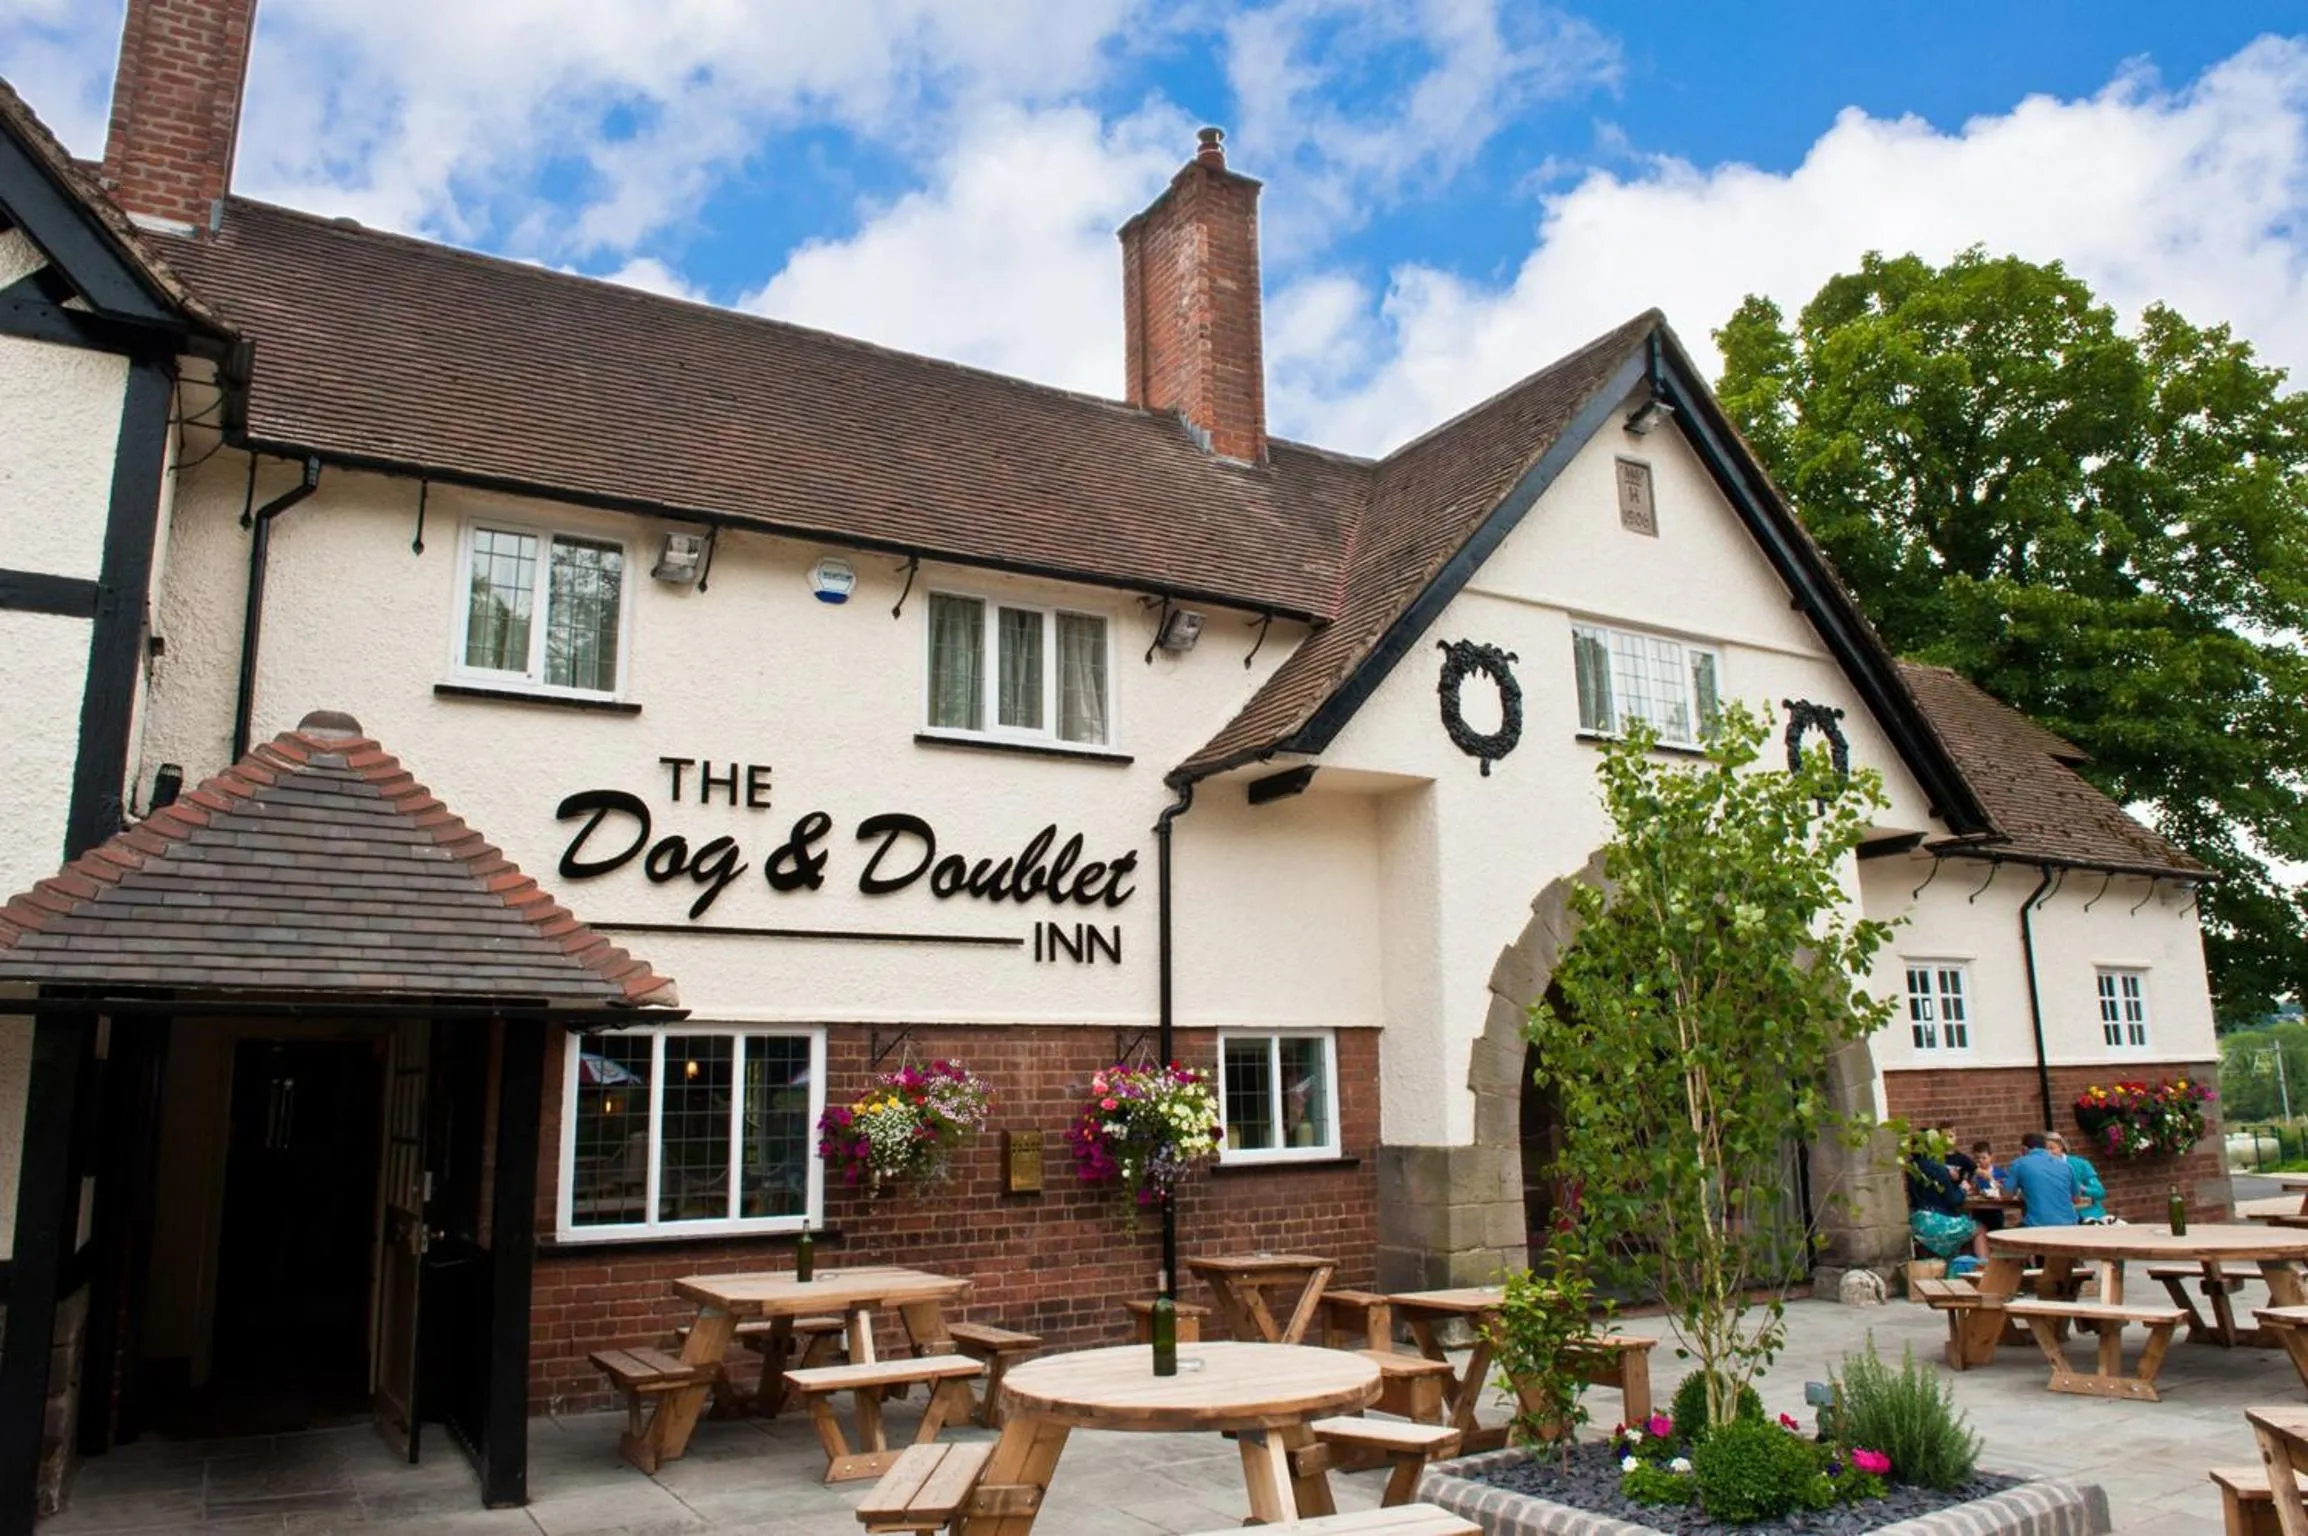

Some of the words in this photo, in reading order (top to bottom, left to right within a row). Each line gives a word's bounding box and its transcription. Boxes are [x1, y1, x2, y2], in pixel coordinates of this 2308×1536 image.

[660, 757, 772, 808] THE
[556, 789, 748, 920] Dog
[764, 811, 833, 894] &
[856, 813, 1138, 908] Doublet
[1034, 922, 1122, 965] INN
